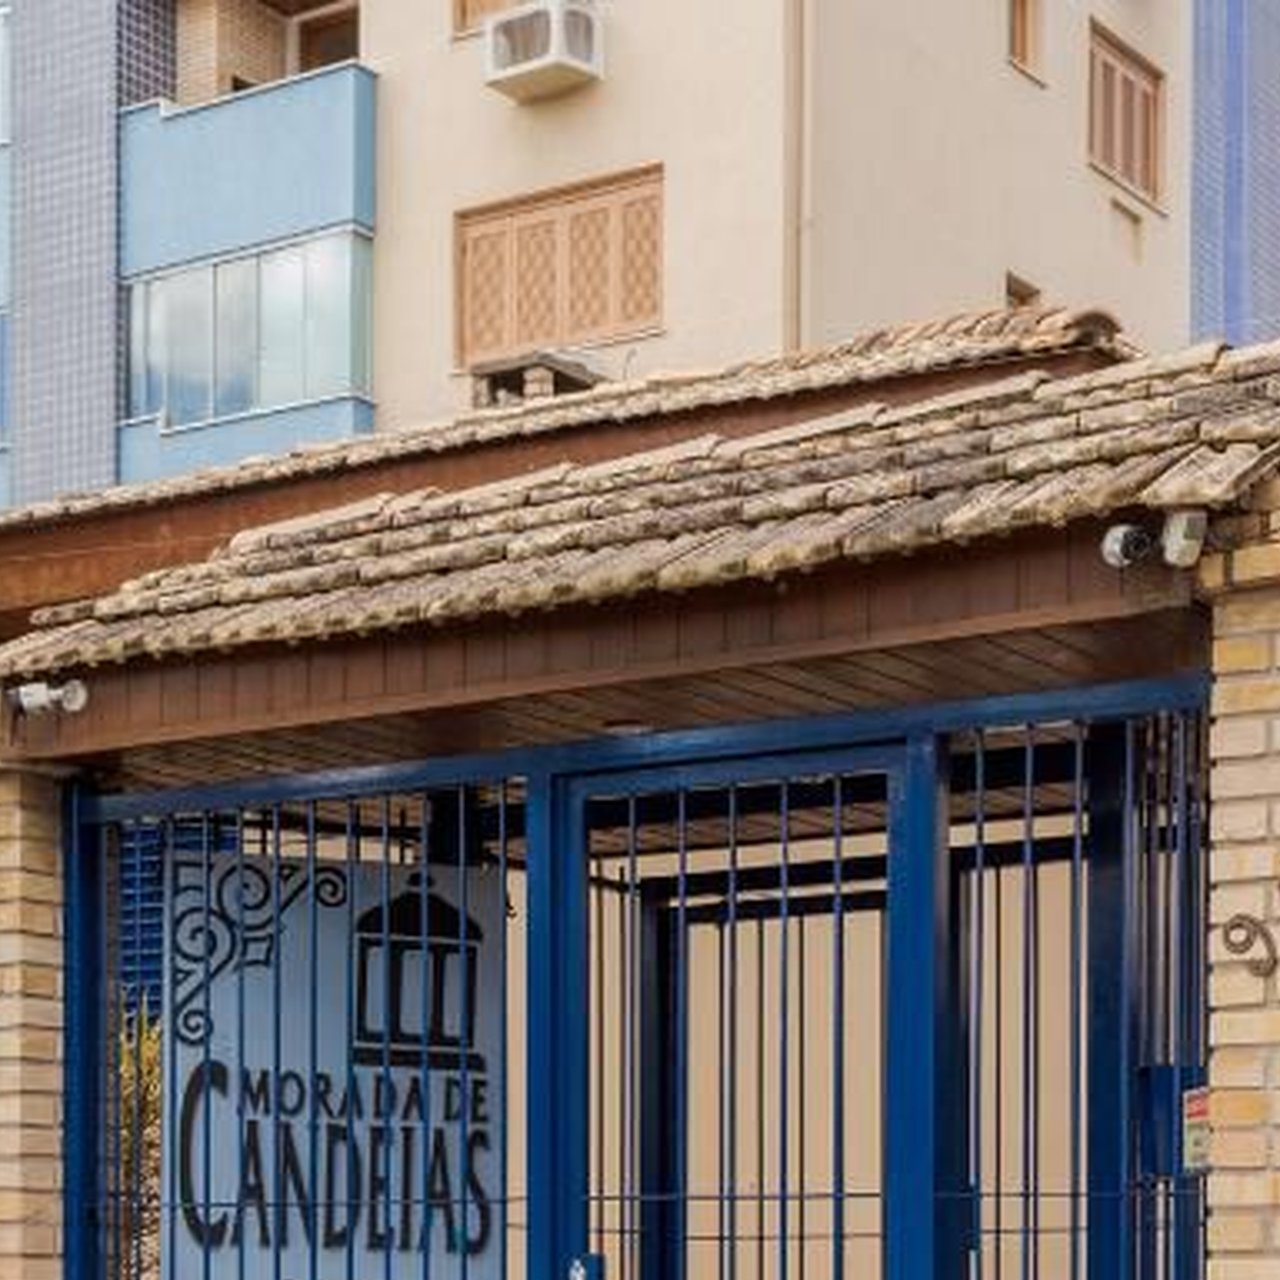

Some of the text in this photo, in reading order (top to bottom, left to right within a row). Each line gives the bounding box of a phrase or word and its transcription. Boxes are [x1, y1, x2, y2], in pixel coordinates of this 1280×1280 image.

[179, 1059, 492, 1254] CANDEIAS
[237, 1067, 490, 1123] MORADA DE
